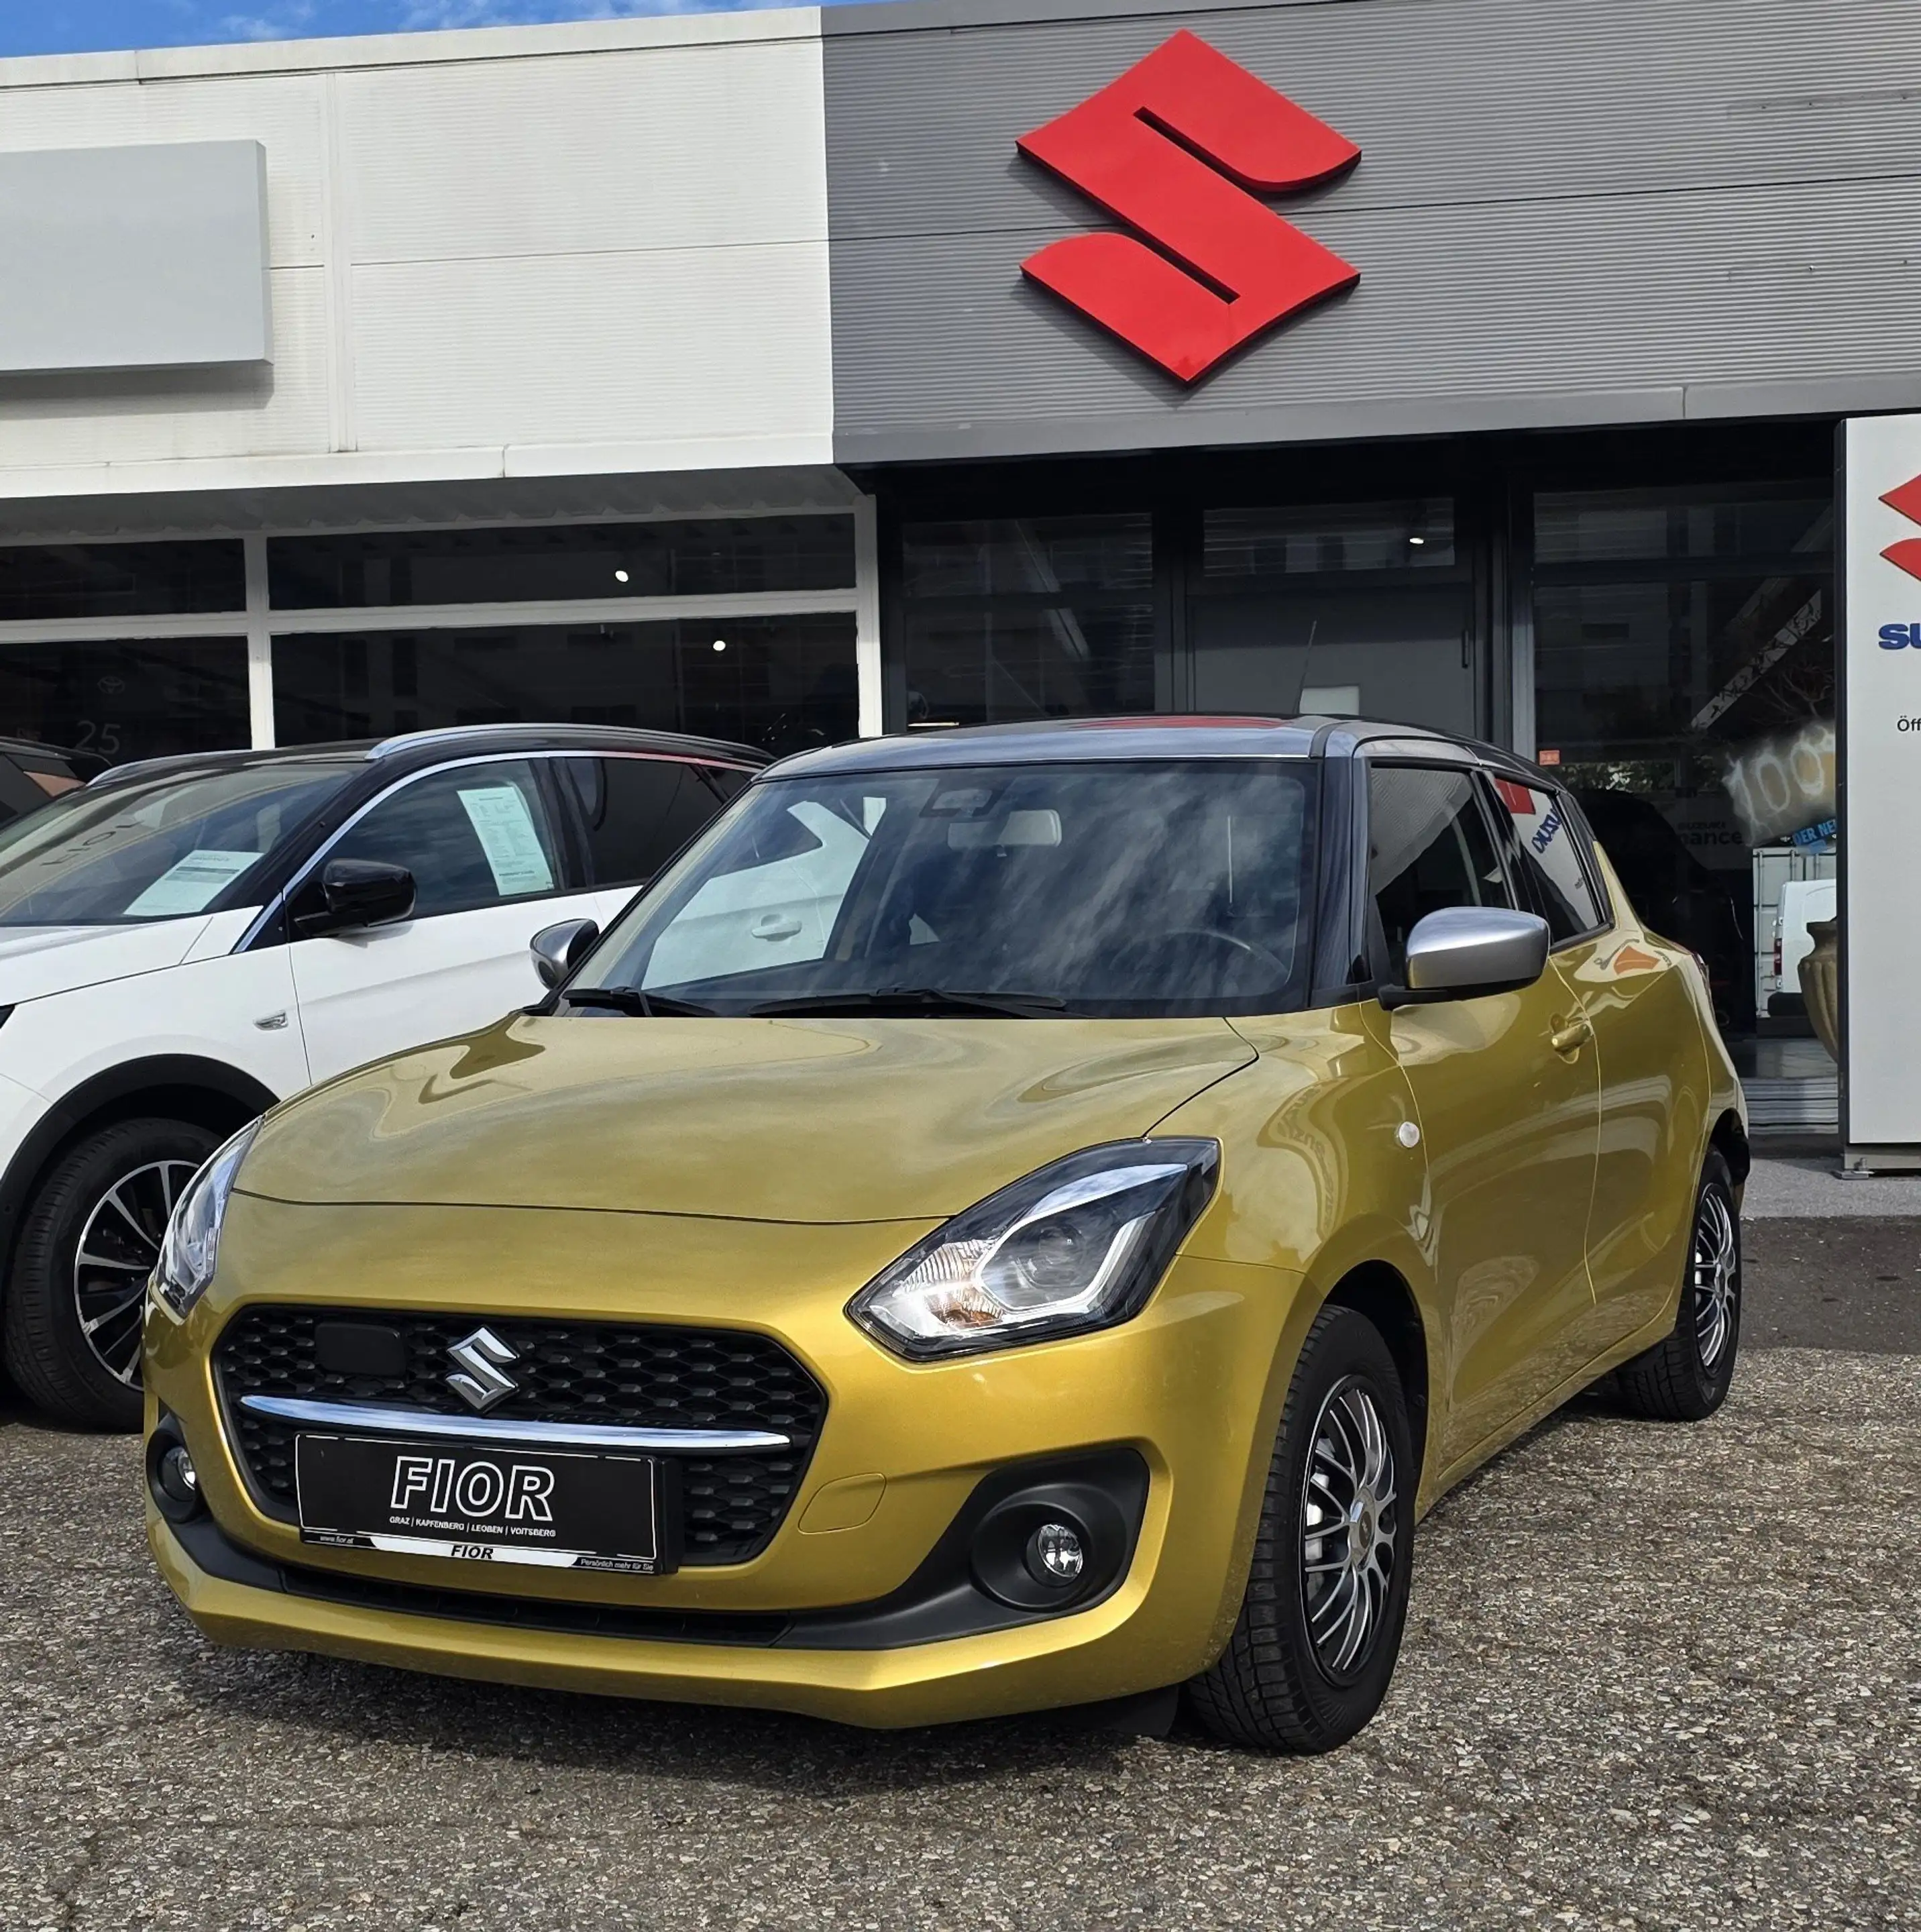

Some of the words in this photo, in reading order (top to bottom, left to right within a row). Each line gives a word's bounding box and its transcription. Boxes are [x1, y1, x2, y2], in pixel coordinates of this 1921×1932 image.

[390, 1455, 555, 1521] FIOR
[389, 1516, 410, 1526] GRAZ
[415, 1518, 465, 1532] KAPFENBERG
[471, 1523, 504, 1535] LEOBEN
[510, 1526, 557, 1538] VOITSBERG
[451, 1544, 494, 1560] FIOR
